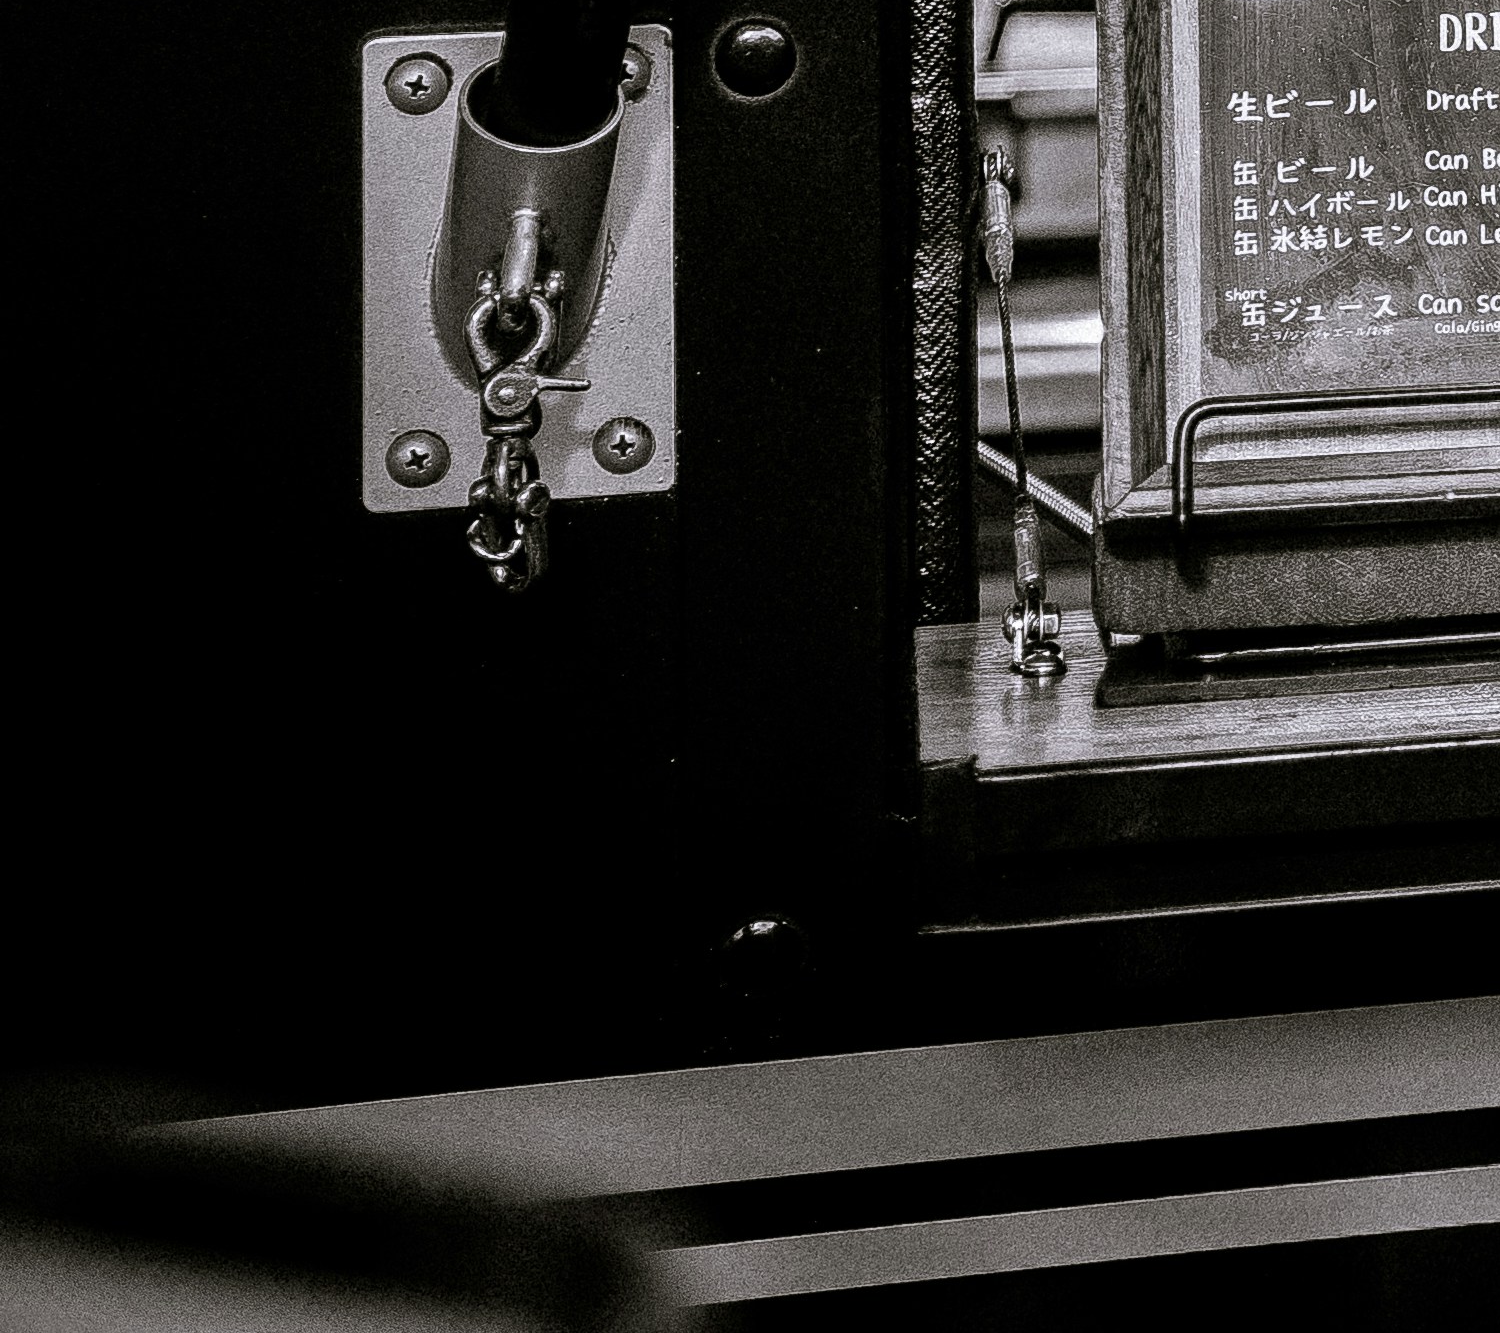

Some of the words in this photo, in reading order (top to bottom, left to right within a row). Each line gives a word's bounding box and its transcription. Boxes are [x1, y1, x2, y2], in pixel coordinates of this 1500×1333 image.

[1227, 86, 1378, 123] 生ビール
[1426, 86, 1500, 112] Draft
[1424, 149, 1469, 171] Can
[1423, 185, 1468, 208] Can
[1425, 225, 1468, 247] Can
[1224, 287, 1268, 303] short
[1418, 292, 1463, 315] Can
[1241, 294, 1399, 327] 缶ジュース
